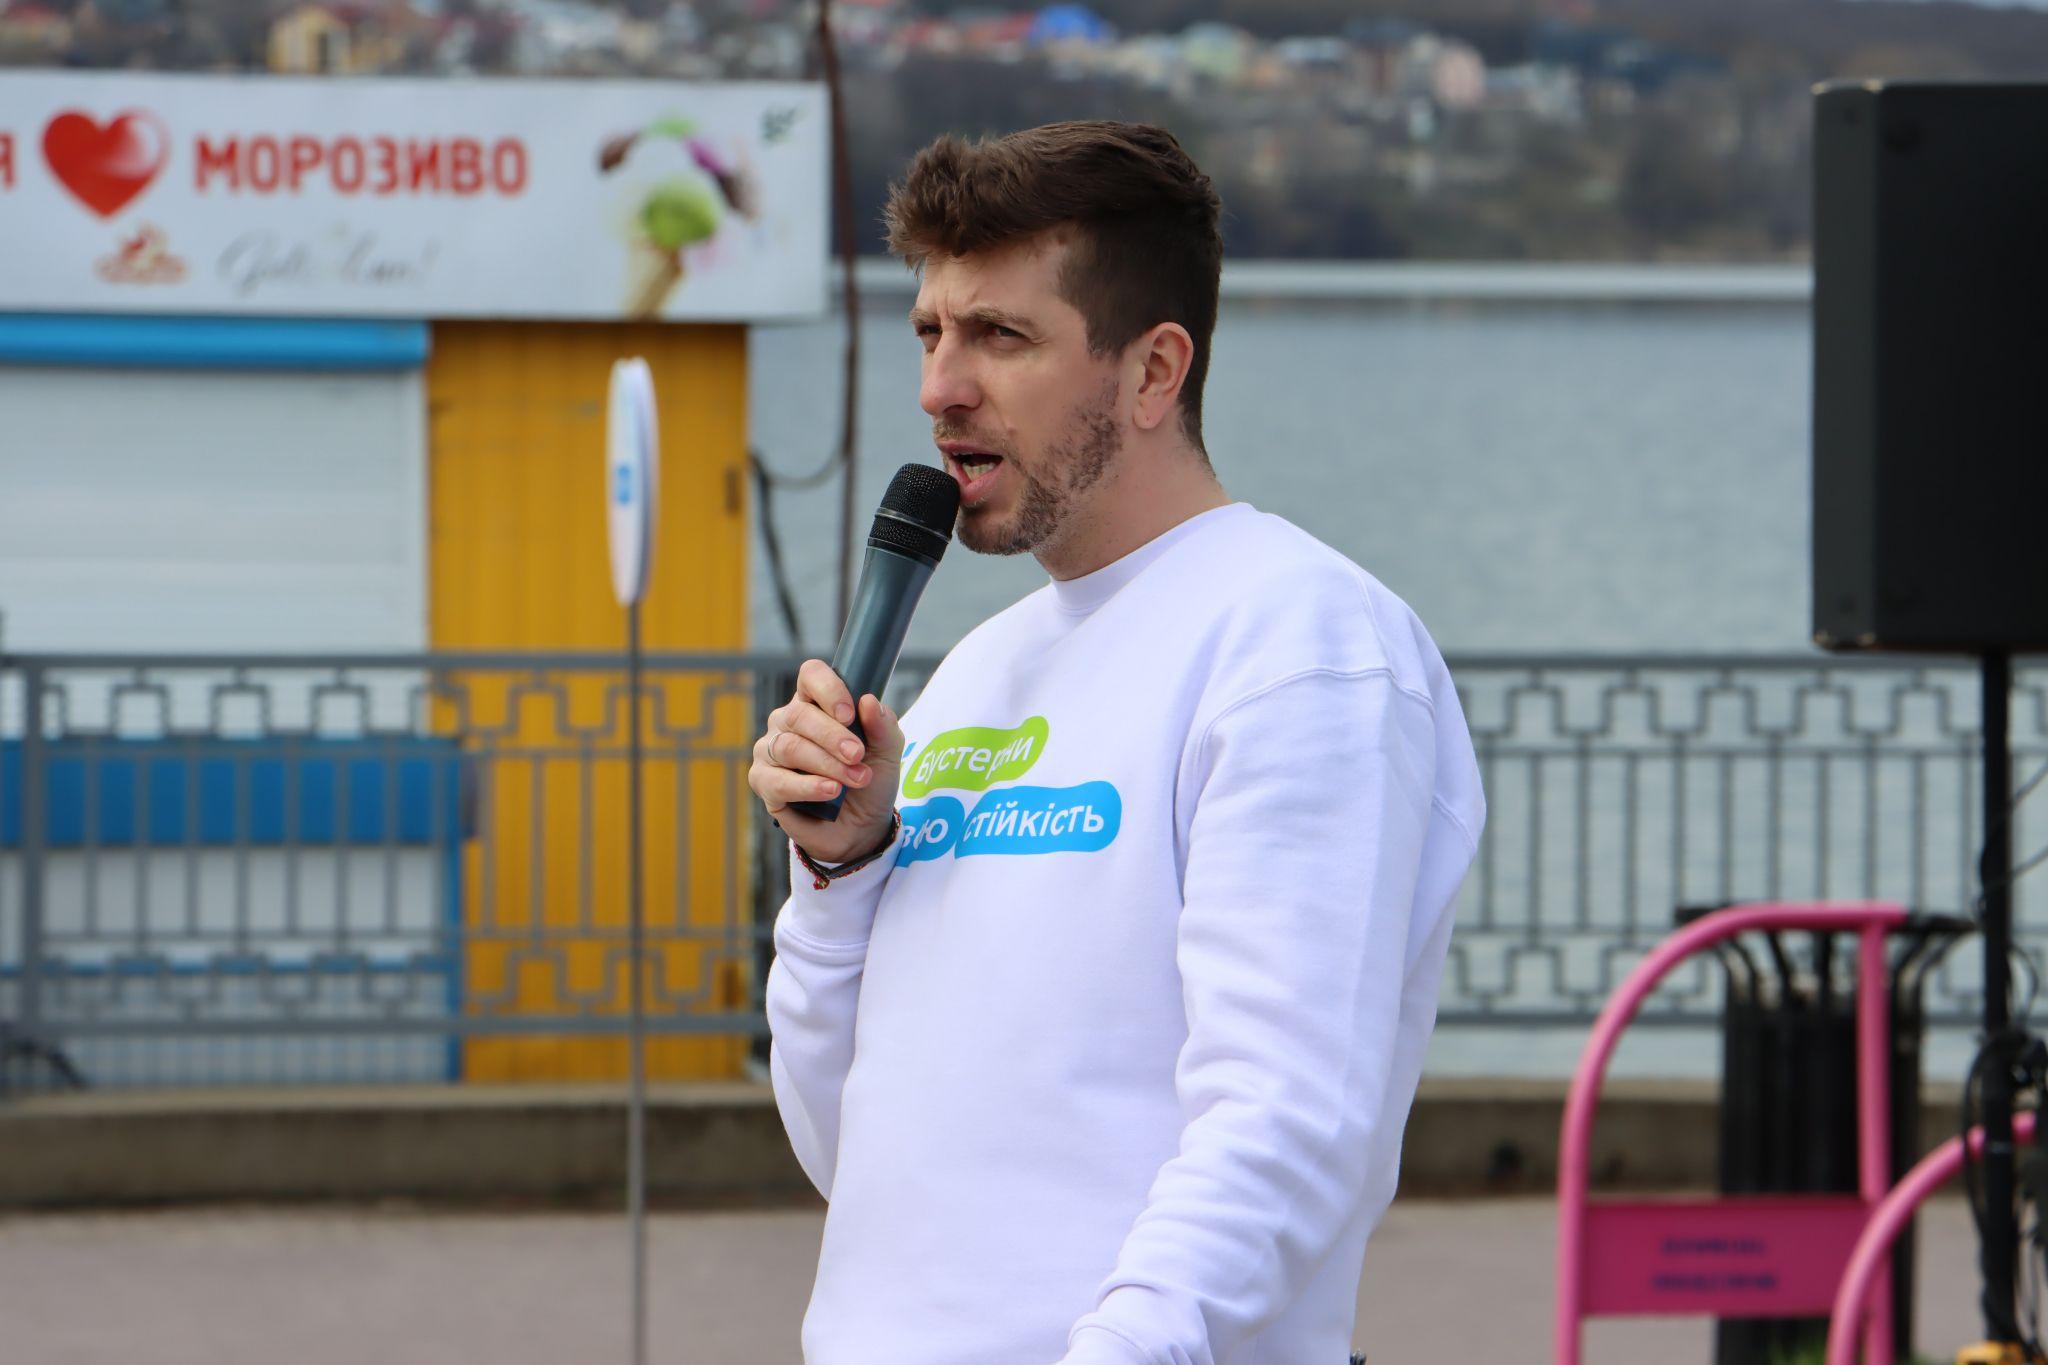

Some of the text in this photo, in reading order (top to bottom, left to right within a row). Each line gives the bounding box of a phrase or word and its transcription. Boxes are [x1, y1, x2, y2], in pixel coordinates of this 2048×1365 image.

[194, 133, 529, 197] МОРОЗИВО
[913, 735, 1035, 785] Бустерни
[962, 800, 1105, 842] стійкість
